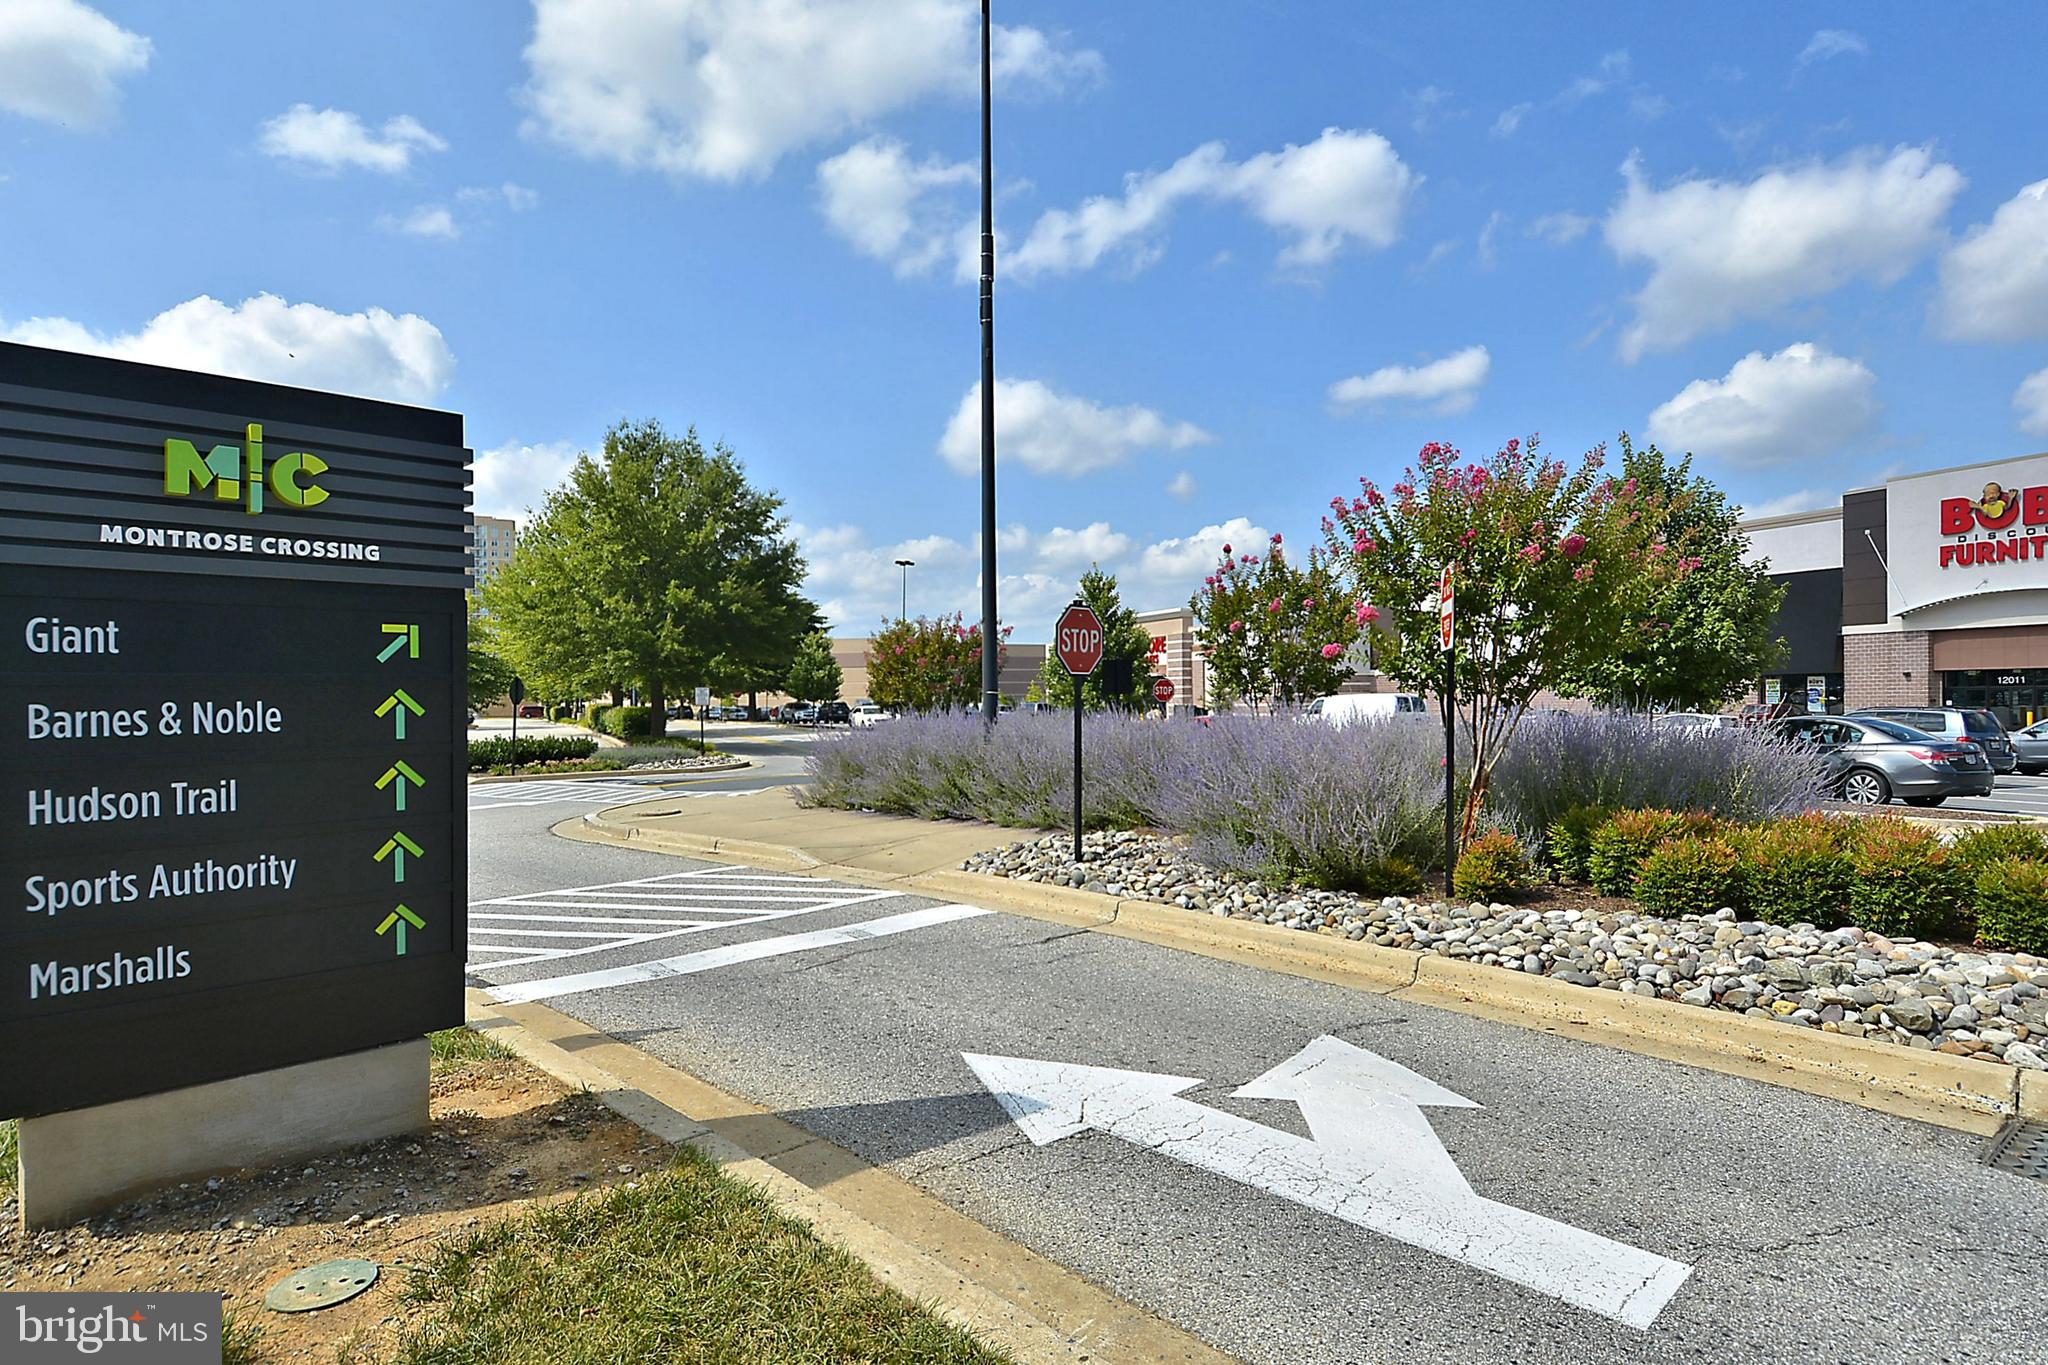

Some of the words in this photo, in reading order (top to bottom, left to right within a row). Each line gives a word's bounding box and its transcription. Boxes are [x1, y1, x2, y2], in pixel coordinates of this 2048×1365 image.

[100, 524, 253, 552] MONTROSE
[260, 537, 381, 561] CROSSING
[1940, 536, 2048, 567] FURNIT
[25, 617, 119, 654] Giant
[1061, 629, 1100, 653] STOP
[1155, 686, 1173, 695] STOP
[1997, 676, 2025, 684] 12011
[28, 703, 149, 740] Barnes
[158, 702, 182, 736] &
[193, 700, 282, 735] Noble
[28, 786, 160, 825] Hudson
[171, 779, 237, 815] Trail
[25, 869, 139, 916] Sports
[149, 855, 296, 899] Authority
[30, 945, 191, 999] Marshalls
